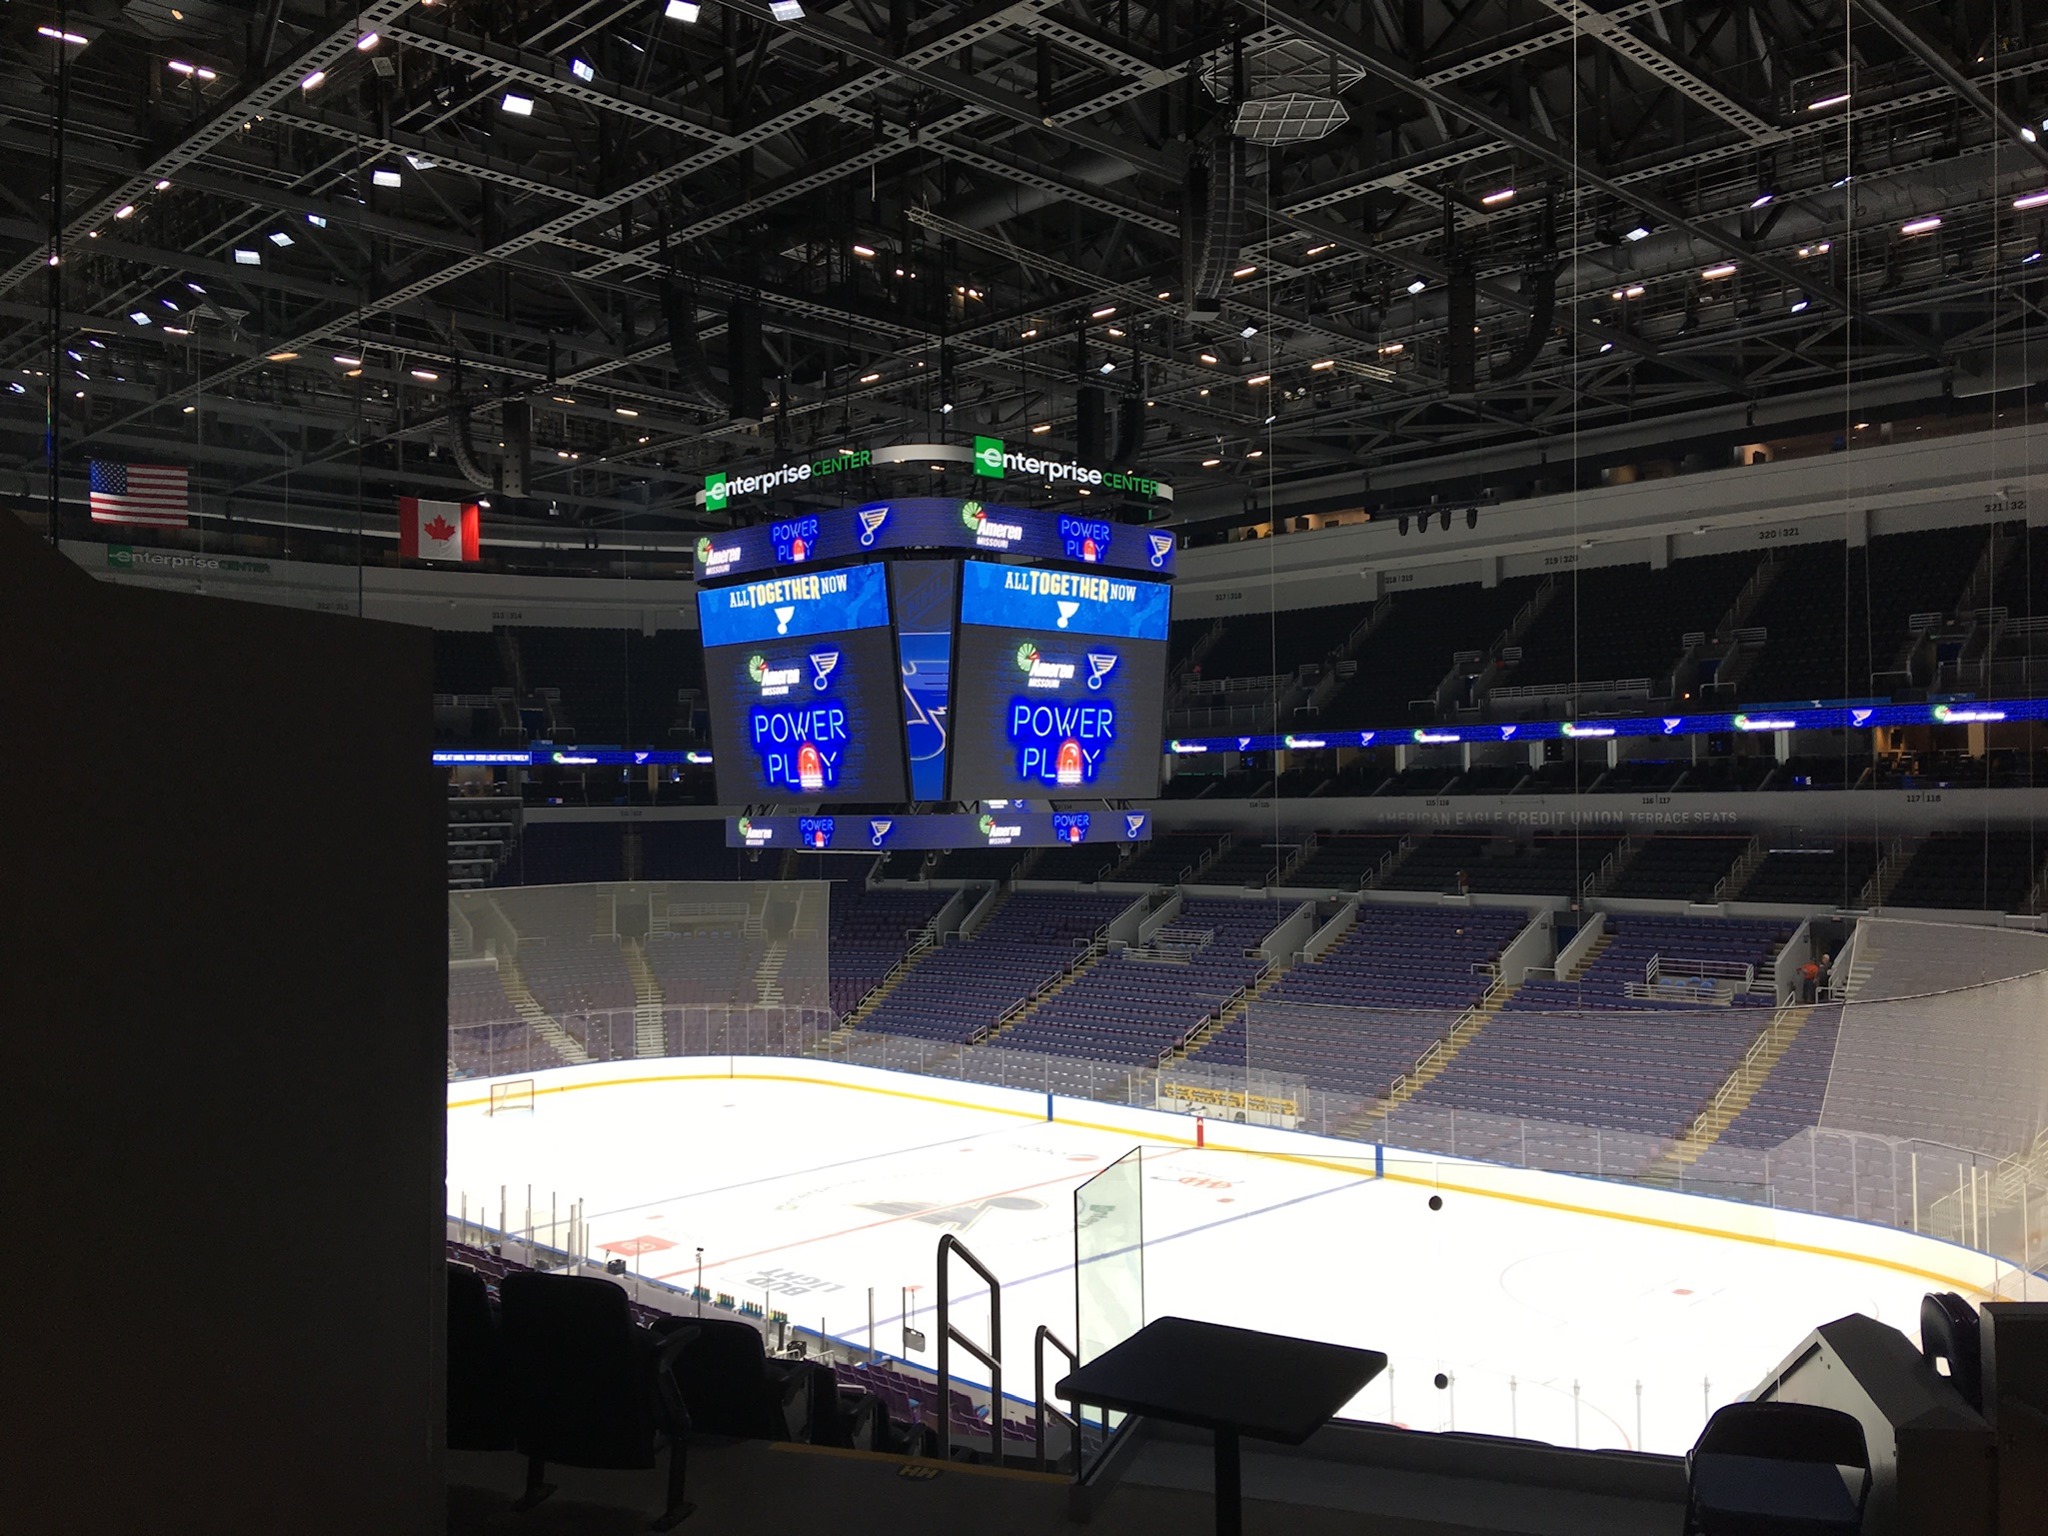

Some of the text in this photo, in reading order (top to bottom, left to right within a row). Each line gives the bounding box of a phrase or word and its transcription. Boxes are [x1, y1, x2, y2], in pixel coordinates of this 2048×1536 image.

[773, 519, 818, 542] POWER
[977, 518, 1022, 541] Ameren
[1061, 520, 1110, 542] POWER
[1759, 528, 1799, 539] 320 321
[977, 537, 1008, 548] MISSOURI
[706, 546, 741, 566] Ameren
[706, 564, 730, 575] MISSOURI
[729, 575, 847, 608] ALL TOGETHER NOW
[1005, 571, 1136, 601] ALL TOGETHER NOW
[762, 667, 800, 687] Ameren
[1033, 656, 1074, 679] Ameren
[1028, 677, 1060, 689] MISSOURI
[755, 708, 846, 743] POWER
[1014, 705, 1112, 739] POWER
[801, 818, 834, 833] POWER
[1053, 814, 1091, 829] POWER
[1378, 811, 1737, 825] AMERICAN EAGLE CREDIT UNION TERRACE SEATS
[990, 824, 1022, 838] Ameren
[746, 1278, 811, 1297] BUD
[757, 1268, 846, 1292] LIGHT
